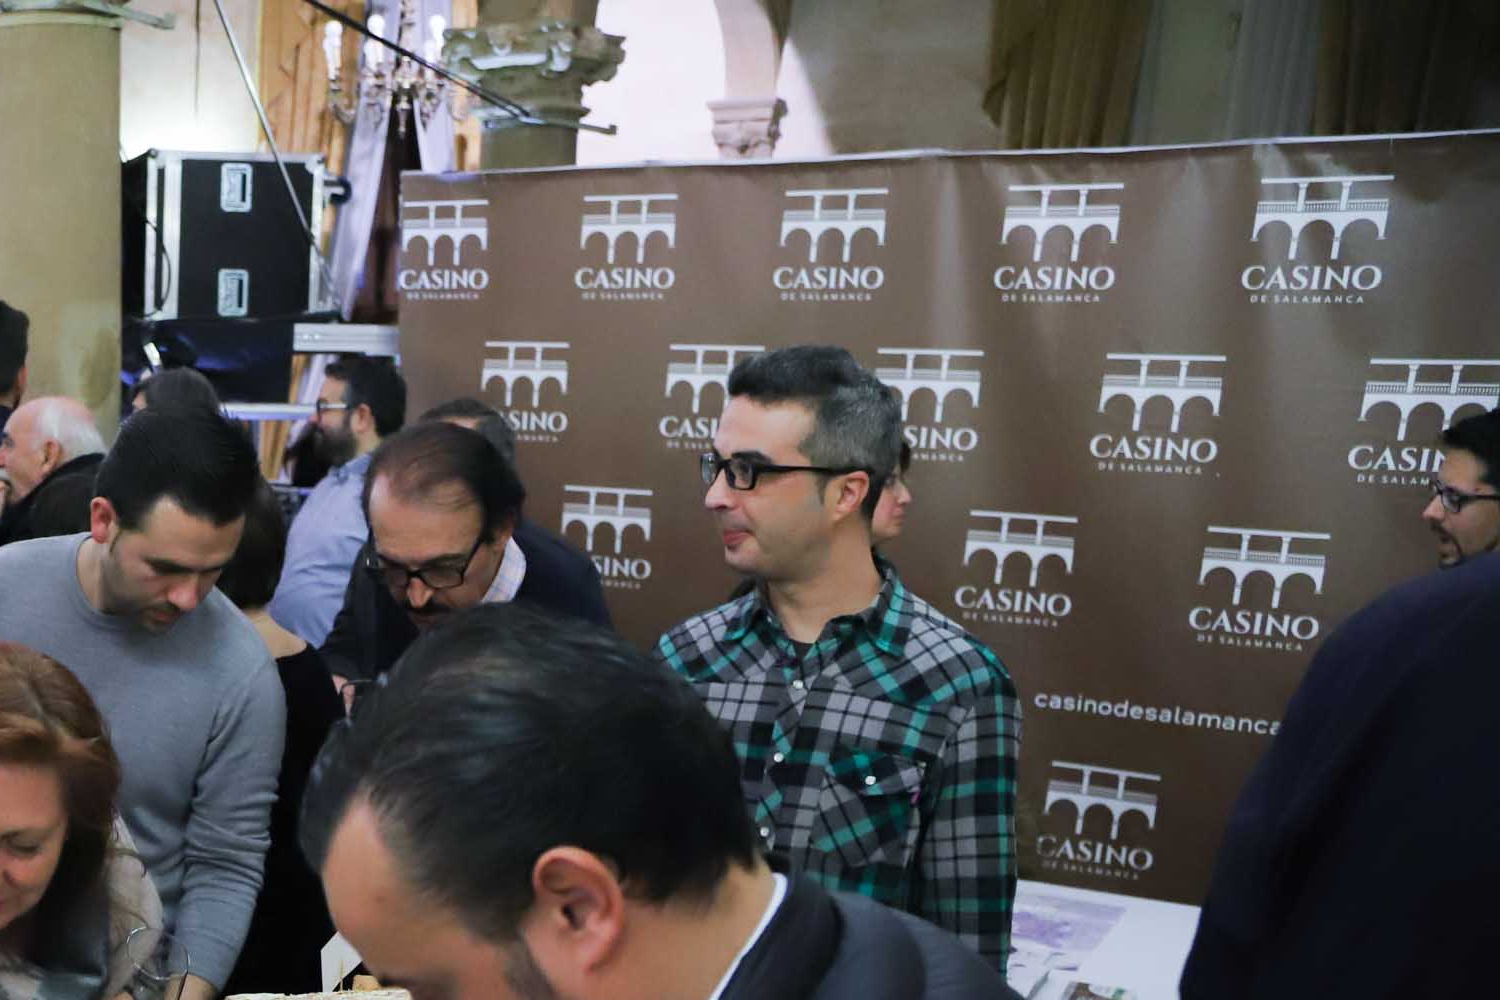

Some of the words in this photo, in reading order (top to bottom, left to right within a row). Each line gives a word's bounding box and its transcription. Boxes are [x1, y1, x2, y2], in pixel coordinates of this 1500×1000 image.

[399, 268, 489, 290] CASINO
[574, 267, 676, 290] CASINO
[771, 265, 885, 290] CASINO
[993, 265, 1116, 291] CASINO
[1241, 265, 1382, 290] CASINO
[1250, 295, 1267, 304] DE
[1274, 295, 1364, 304] SALAMANCA
[505, 411, 568, 433] SINO
[658, 415, 720, 439] CASI
[901, 425, 979, 451] SINO
[1089, 433, 1219, 464] CASINO
[1347, 445, 1447, 472] CASIN
[1357, 474, 1375, 483] DE
[1381, 475, 1431, 486] SALAM
[591, 555, 652, 579] SINO
[954, 585, 1072, 618] CASINO
[1188, 606, 1321, 641] CASINO
[1036, 835, 1154, 872] CASINO
